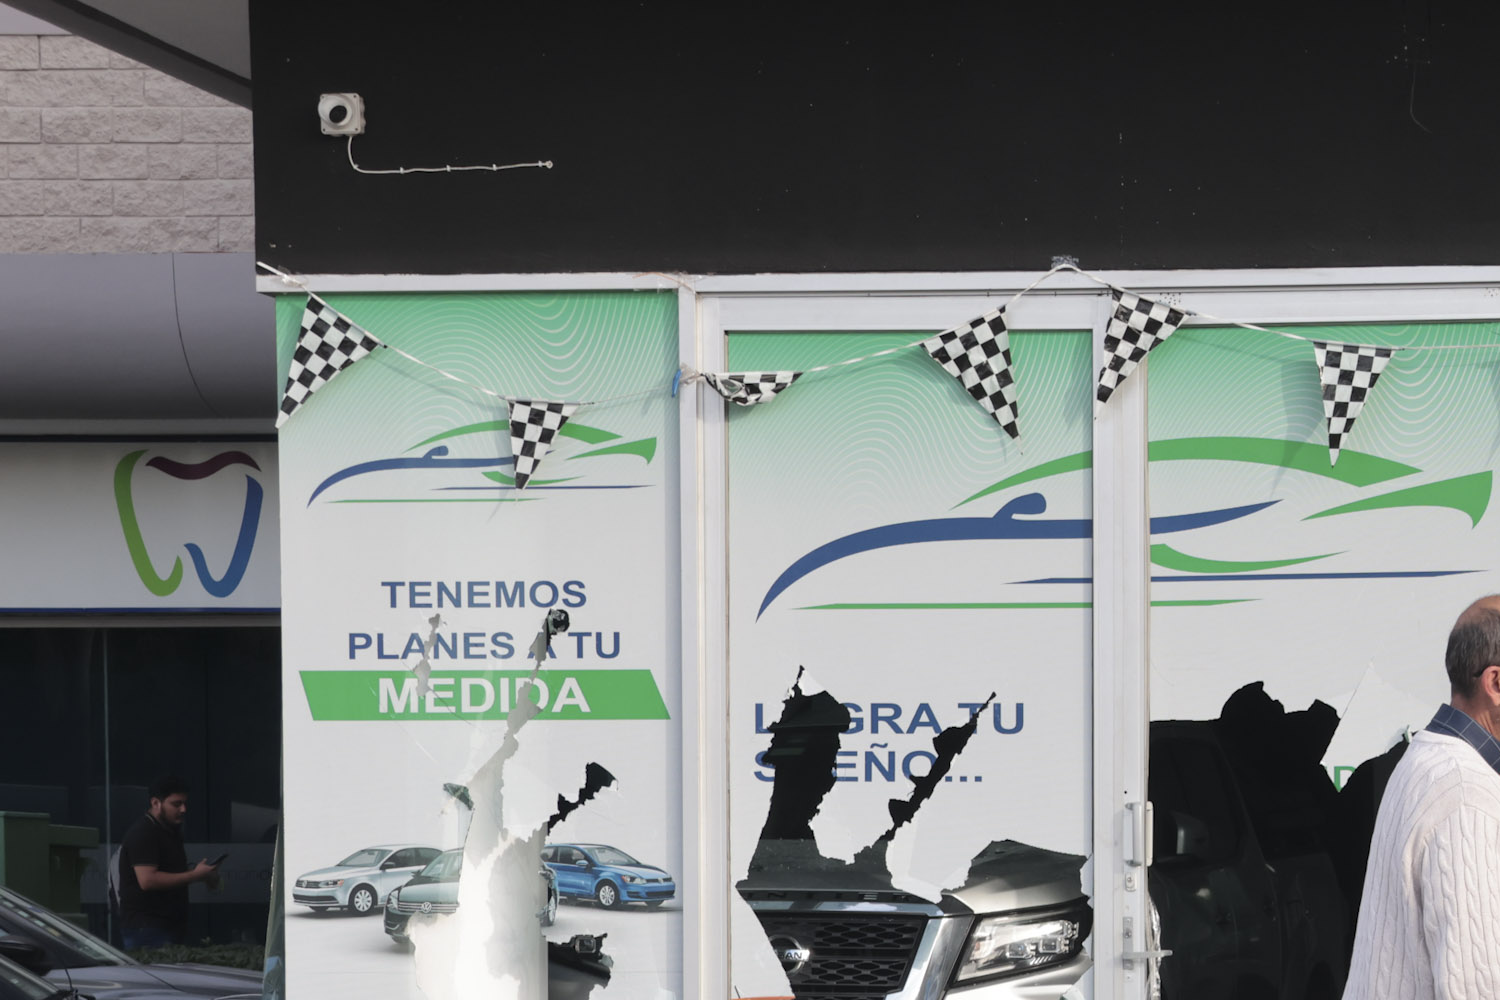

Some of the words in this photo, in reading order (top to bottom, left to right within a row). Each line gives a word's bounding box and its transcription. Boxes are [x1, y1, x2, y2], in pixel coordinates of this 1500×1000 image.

[381, 580, 587, 609] TENEMOS
[348, 632, 515, 660] PLANES
[568, 631, 621, 660] TU
[378, 677, 592, 714] MEDIDA
[755, 702, 942, 735] LGRA
[957, 702, 1025, 735] TU
[753, 742, 983, 783] SEÑO...
